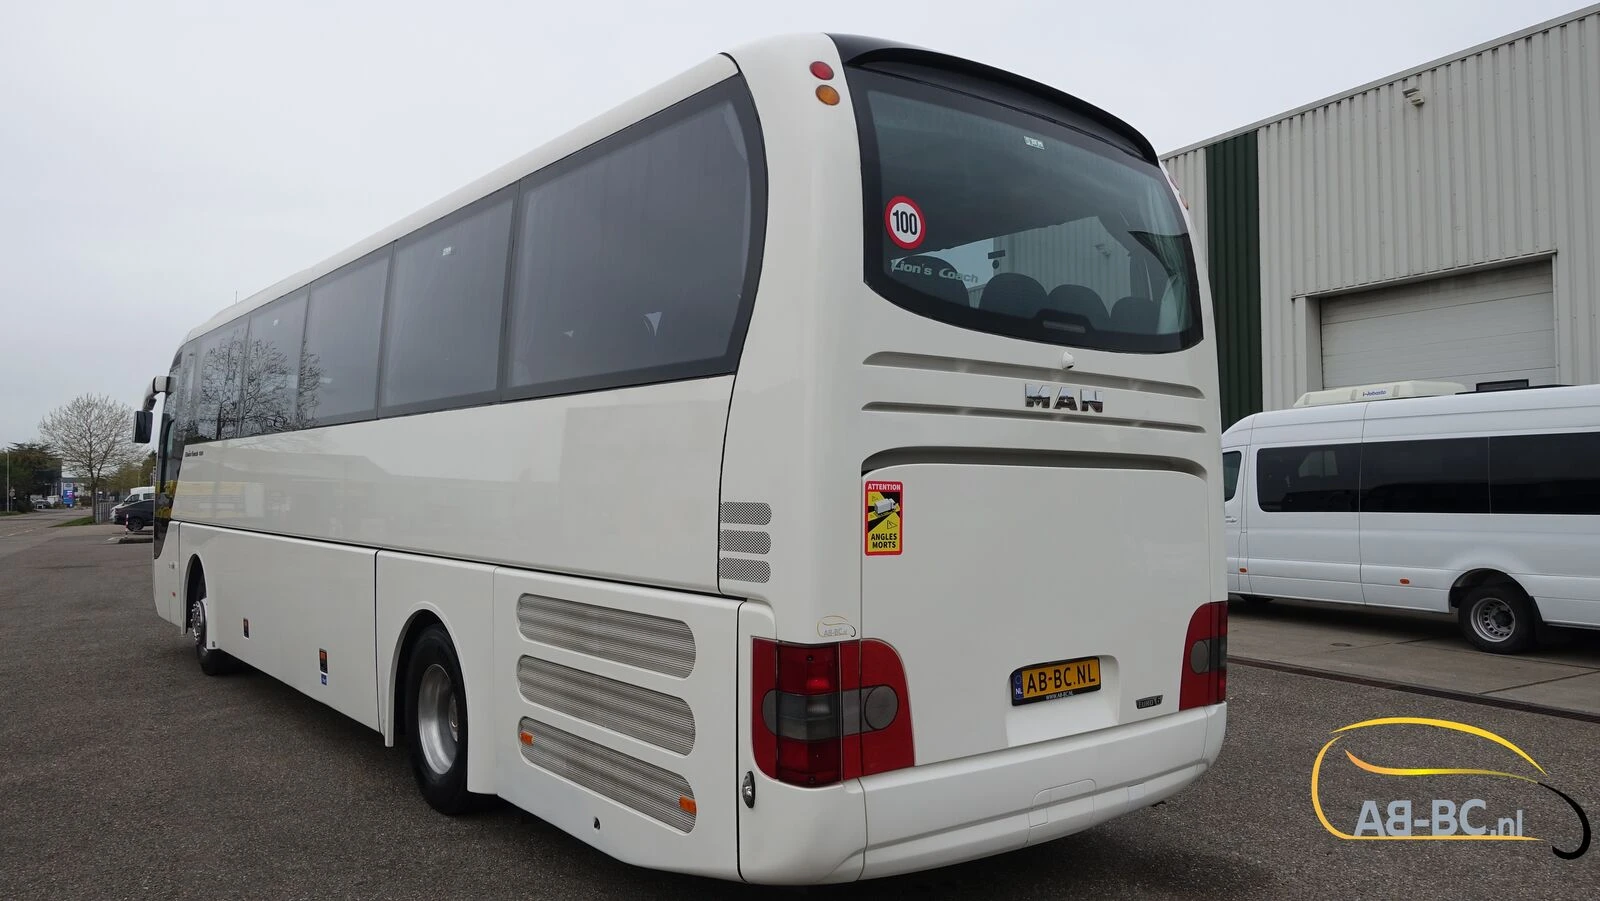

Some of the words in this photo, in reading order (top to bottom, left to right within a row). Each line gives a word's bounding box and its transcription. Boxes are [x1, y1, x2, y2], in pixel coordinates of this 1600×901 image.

[892, 209, 918, 236] 100
[890, 259, 933, 276] Lion's
[938, 267, 979, 284] Coach
[1024, 383, 1104, 413] MAN
[867, 483, 901, 491] ATTENTION
[870, 533, 898, 541] ANGLES
[872, 541, 897, 549] MORTS
[1026, 663, 1096, 695] AB-BC.NL
[1015, 687, 1023, 695] NL
